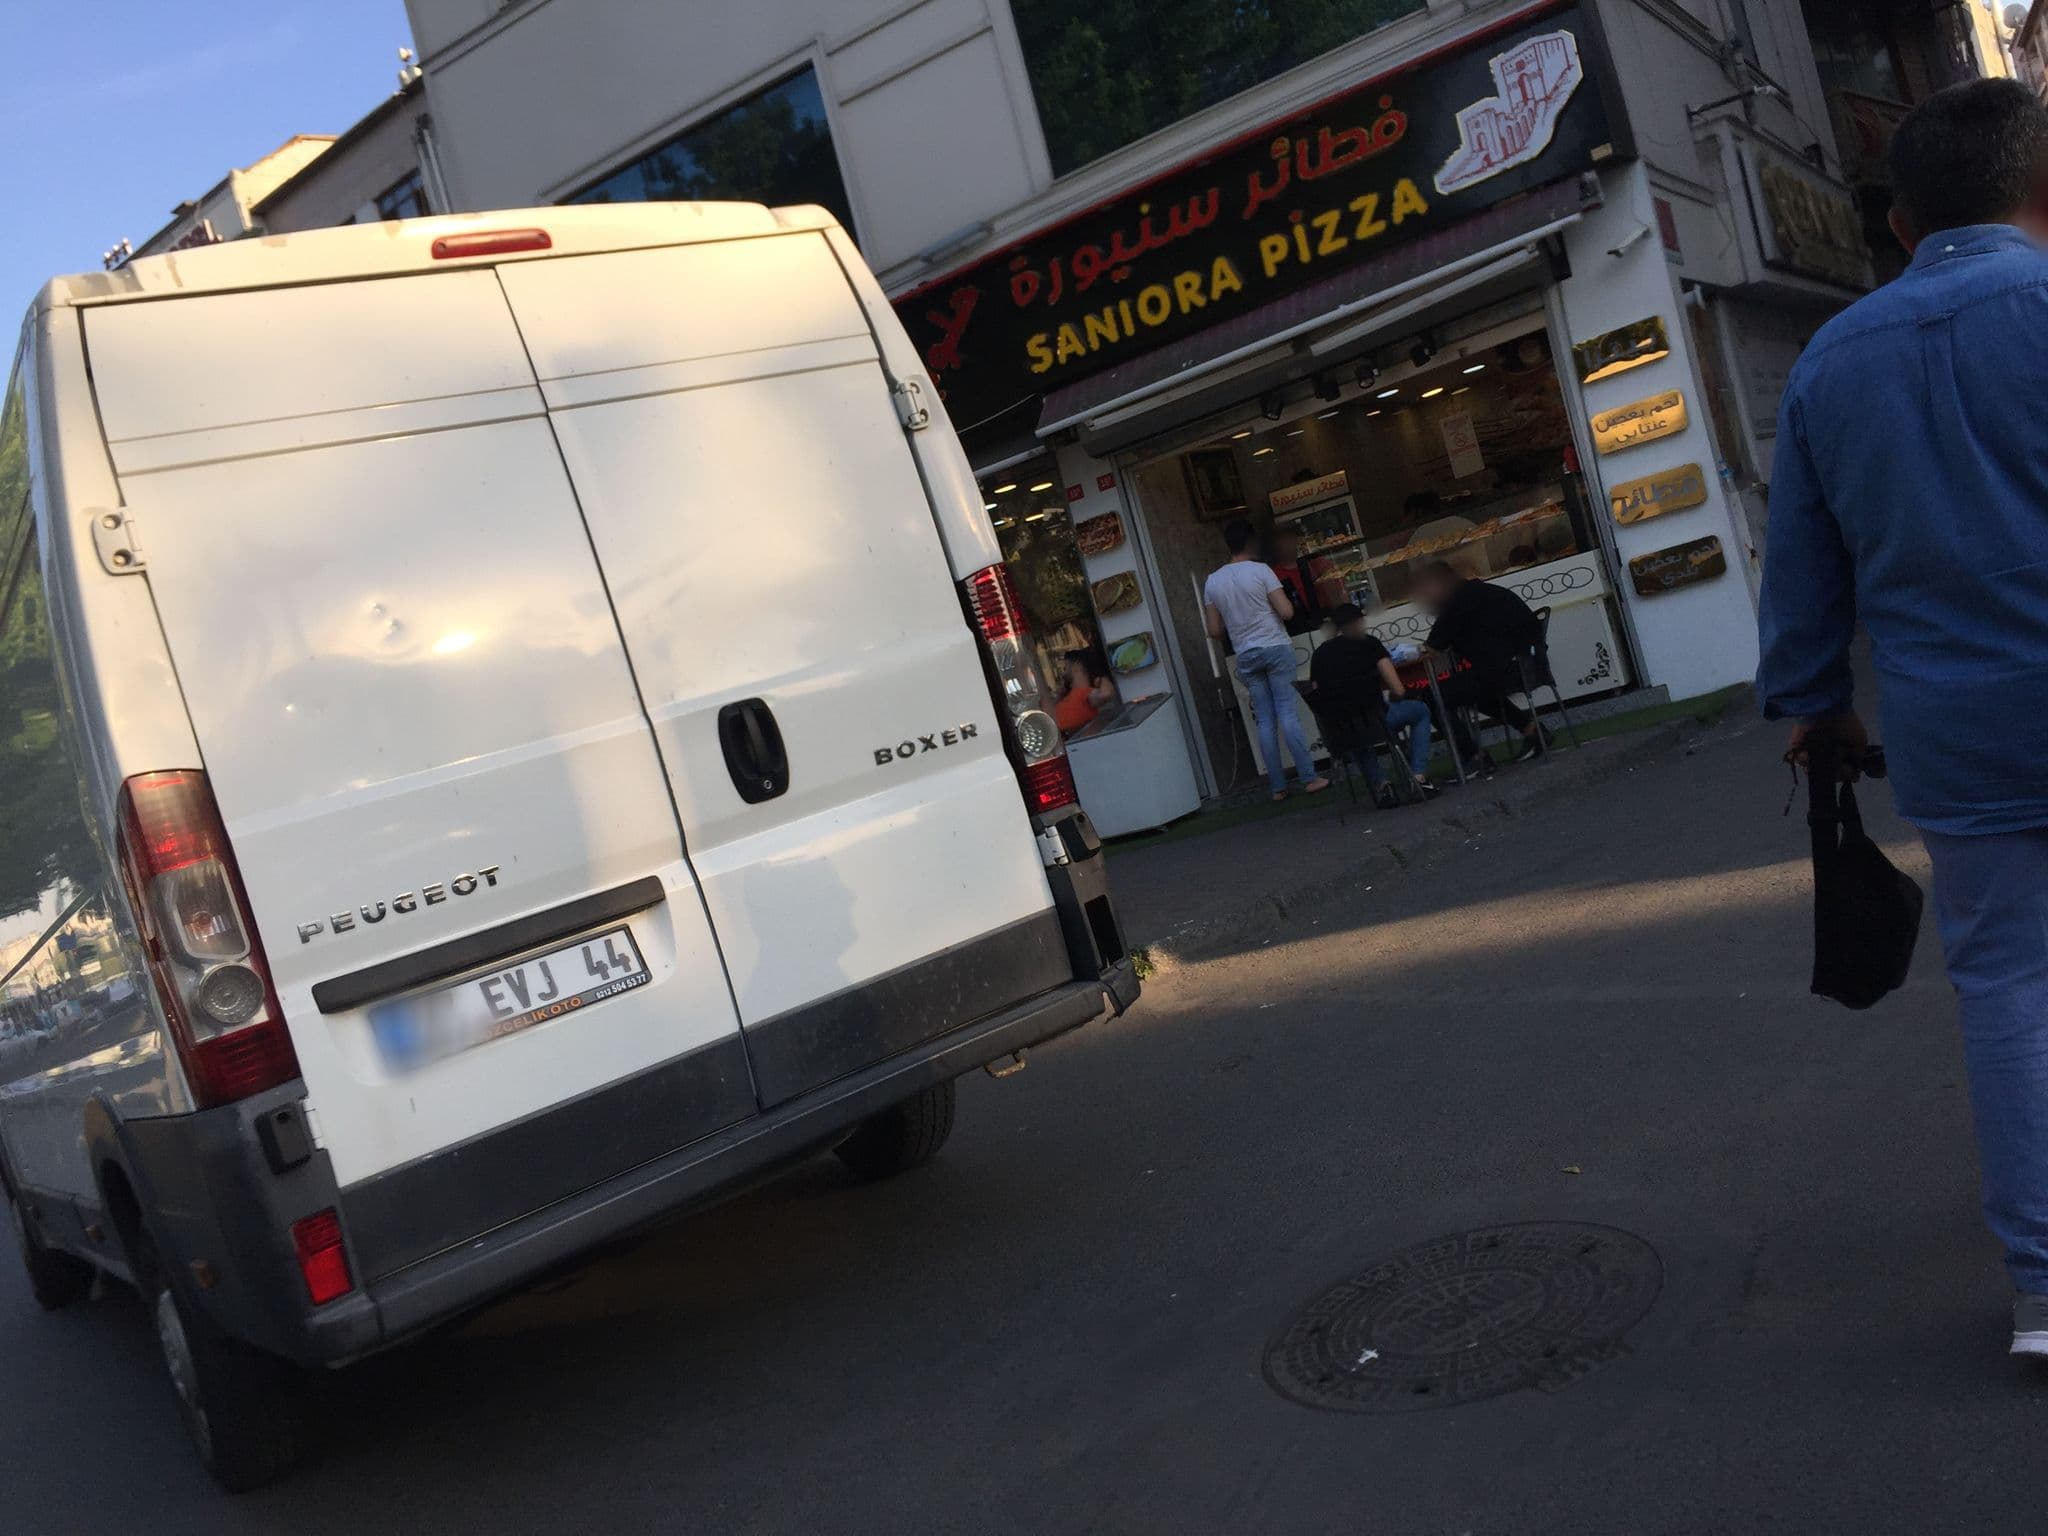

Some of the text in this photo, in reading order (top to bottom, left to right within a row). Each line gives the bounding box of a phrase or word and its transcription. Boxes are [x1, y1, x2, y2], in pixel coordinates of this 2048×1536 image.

[1010, 97, 1407, 307] فطائر سنيورة
[1026, 256, 1242, 374] SANIORA
[874, 722, 978, 765] BOXER
[297, 864, 499, 944] PEUGEOT
[479, 938, 632, 1019] EVJ 44
[550, 996, 582, 1016] OTO
